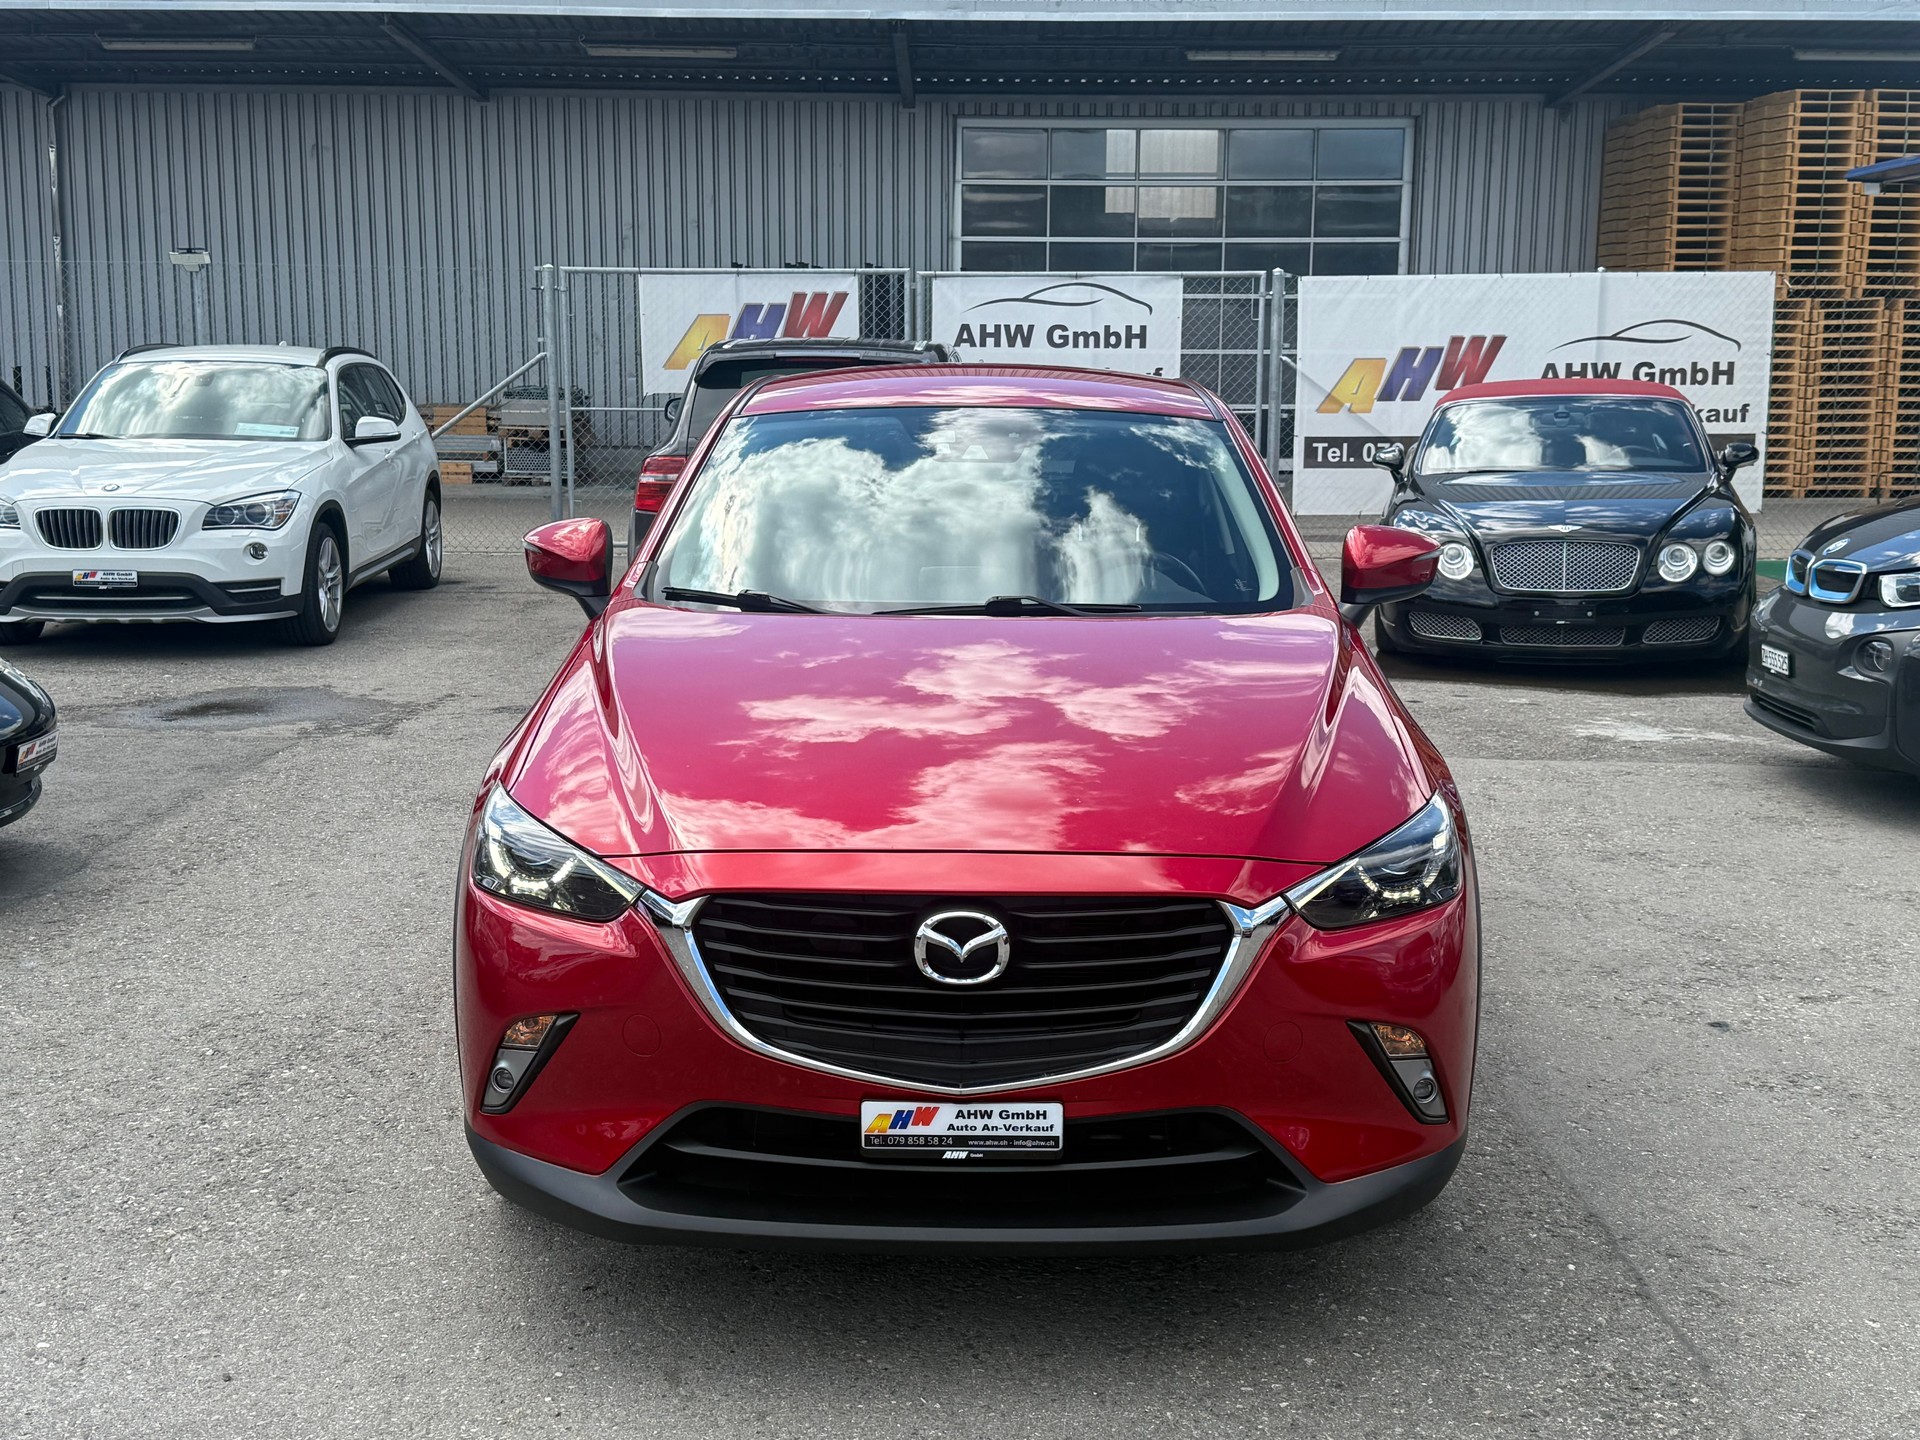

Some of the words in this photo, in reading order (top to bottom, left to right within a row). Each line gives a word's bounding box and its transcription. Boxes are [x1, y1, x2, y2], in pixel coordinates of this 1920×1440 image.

[662, 291, 849, 370] AHW
[953, 323, 1035, 348] AHW
[1046, 324, 1147, 349] GmbH
[1315, 334, 1507, 413] AHW
[1541, 361, 1622, 379] AHW
[1632, 361, 1735, 386] GmbH
[1313, 443, 1354, 462] Tel.
[864, 1106, 940, 1133] AHW
[955, 1109, 993, 1120] AHW
[999, 1109, 1047, 1120] GmbH
[947, 1123, 977, 1132] Auto
[982, 1123, 1055, 1132] An-Verkauf
[870, 1136, 885, 1145] Tel.
[887, 1136, 905, 1146] 079
[907, 1136, 925, 1146] 858
[928, 1136, 939, 1146] 58
[942, 1136, 953, 1146] 24
[942, 1151, 969, 1159] AHW
